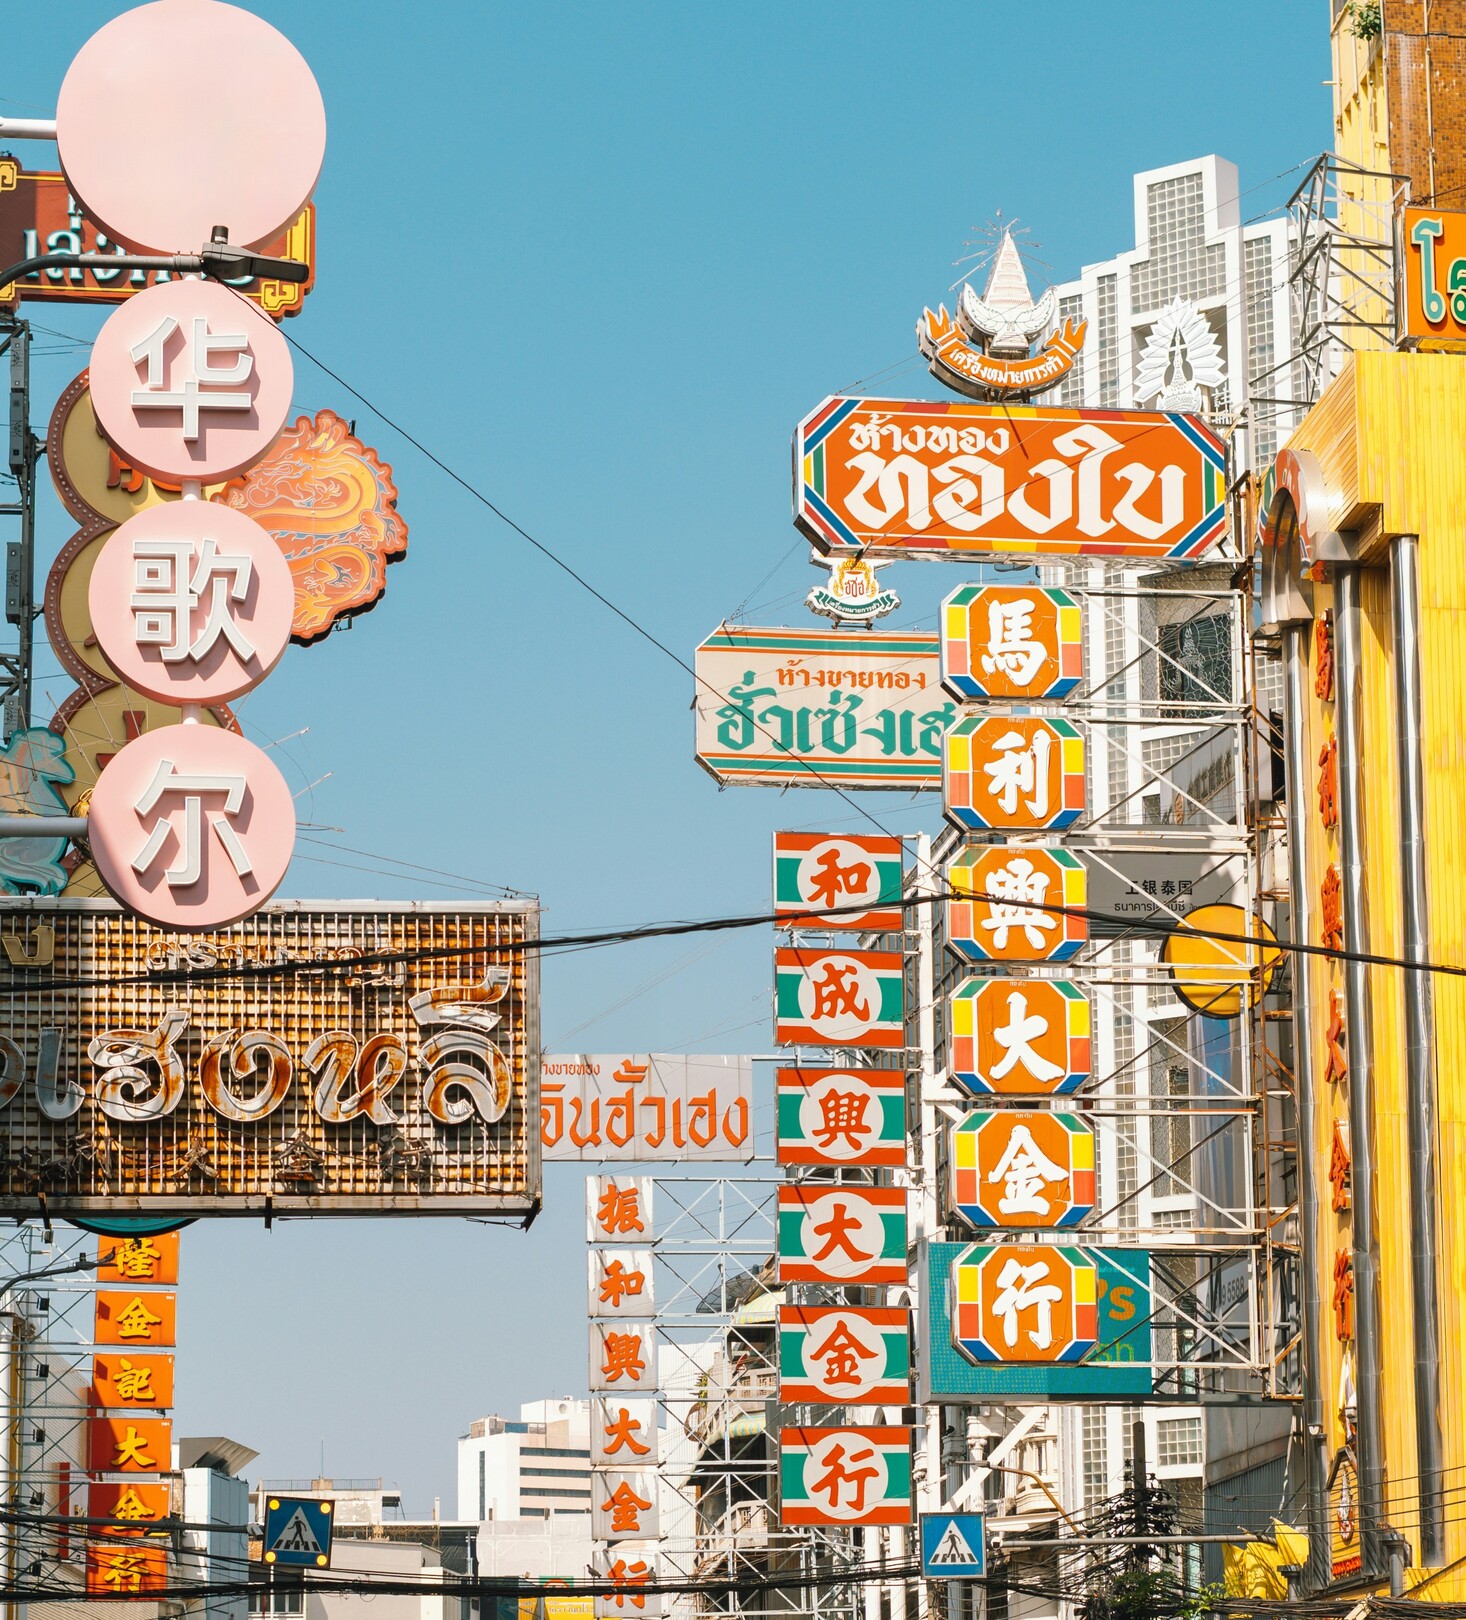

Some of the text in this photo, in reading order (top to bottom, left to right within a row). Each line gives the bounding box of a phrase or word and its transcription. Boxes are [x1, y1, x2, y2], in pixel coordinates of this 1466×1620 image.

[842, 424, 1188, 540] ทองใบ
[848, 413, 1010, 455] ห้างทอง
[129, 315, 257, 887] 华歌尔
[776, 658, 926, 689] ห้างขายทอง
[1125, 880, 1193, 895] 工银泰国
[981, 599, 1069, 1350] 馬利興大金行
[541, 1063, 601, 1075] างขายทอง
[807, 848, 879, 1511] 和成興大金行
[597, 1184, 653, 1609] 振和興大金行
